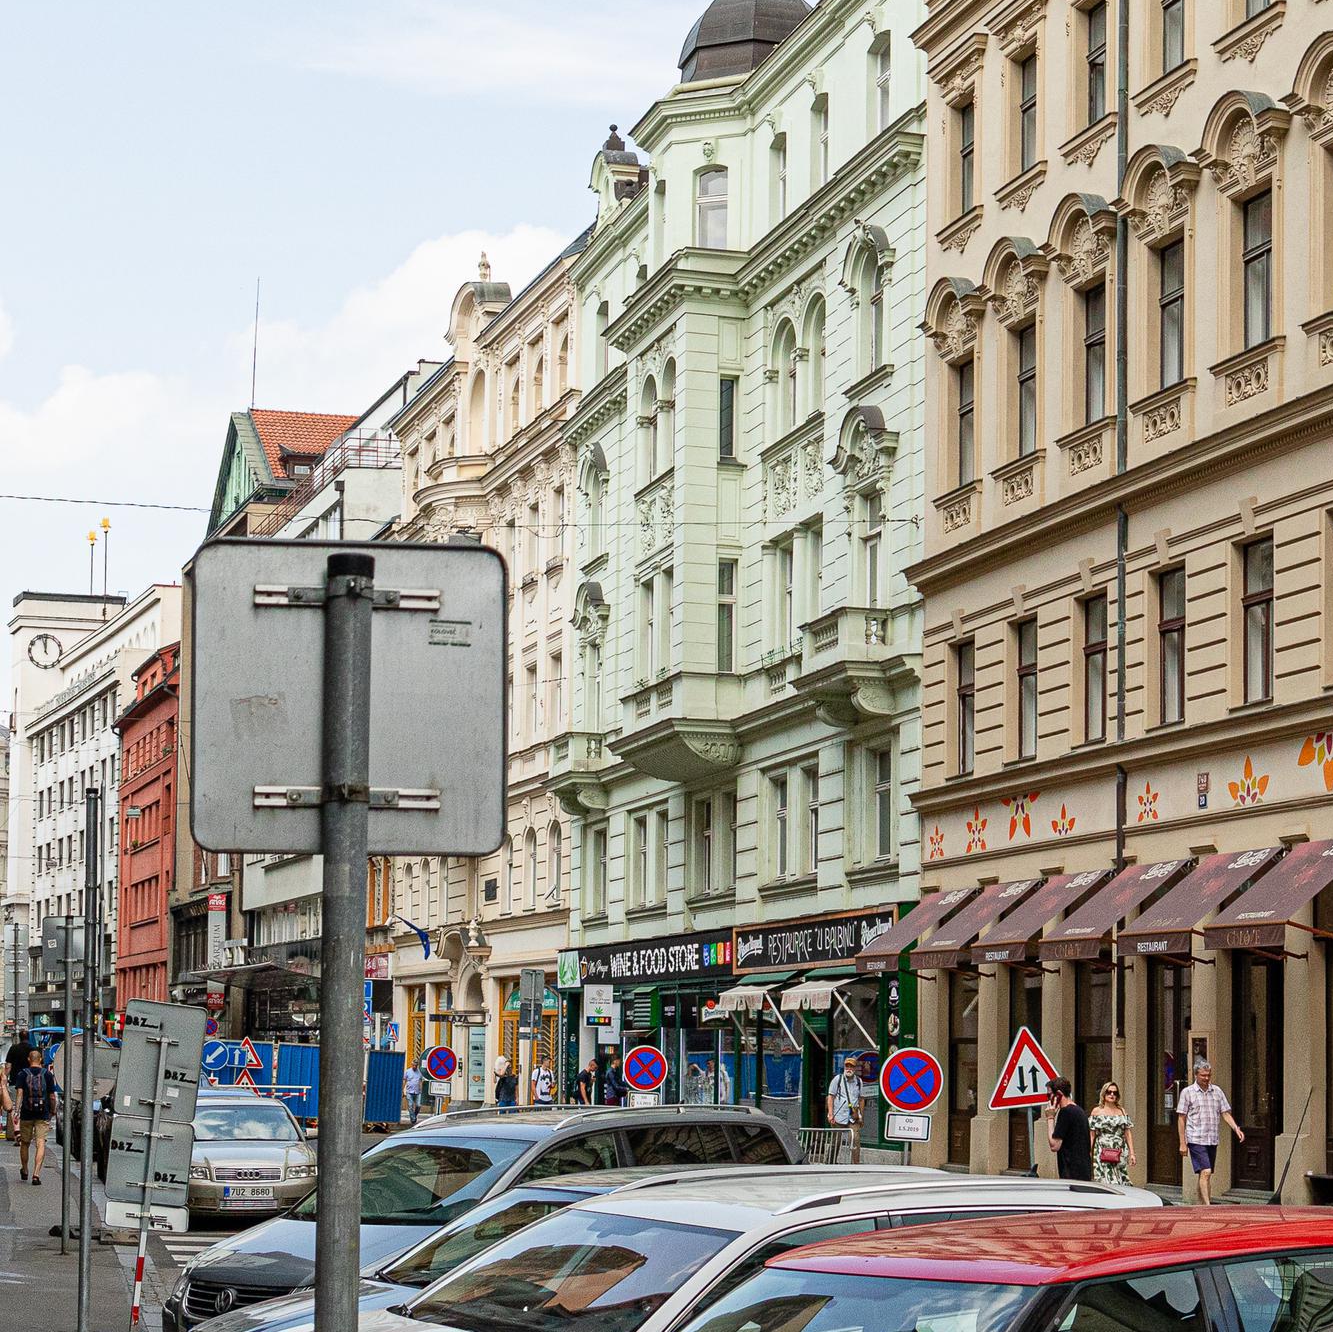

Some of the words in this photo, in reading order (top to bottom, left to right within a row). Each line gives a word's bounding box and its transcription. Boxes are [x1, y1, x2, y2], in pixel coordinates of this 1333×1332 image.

[1137, 940, 1168, 952] RESTAURANT
[610, 953, 631, 978] WINE
[632, 949, 640, 976] &
[639, 947, 667, 975] FOOD
[668, 943, 699, 973] STORE
[985, 951, 1009, 961] RESTAURANT
